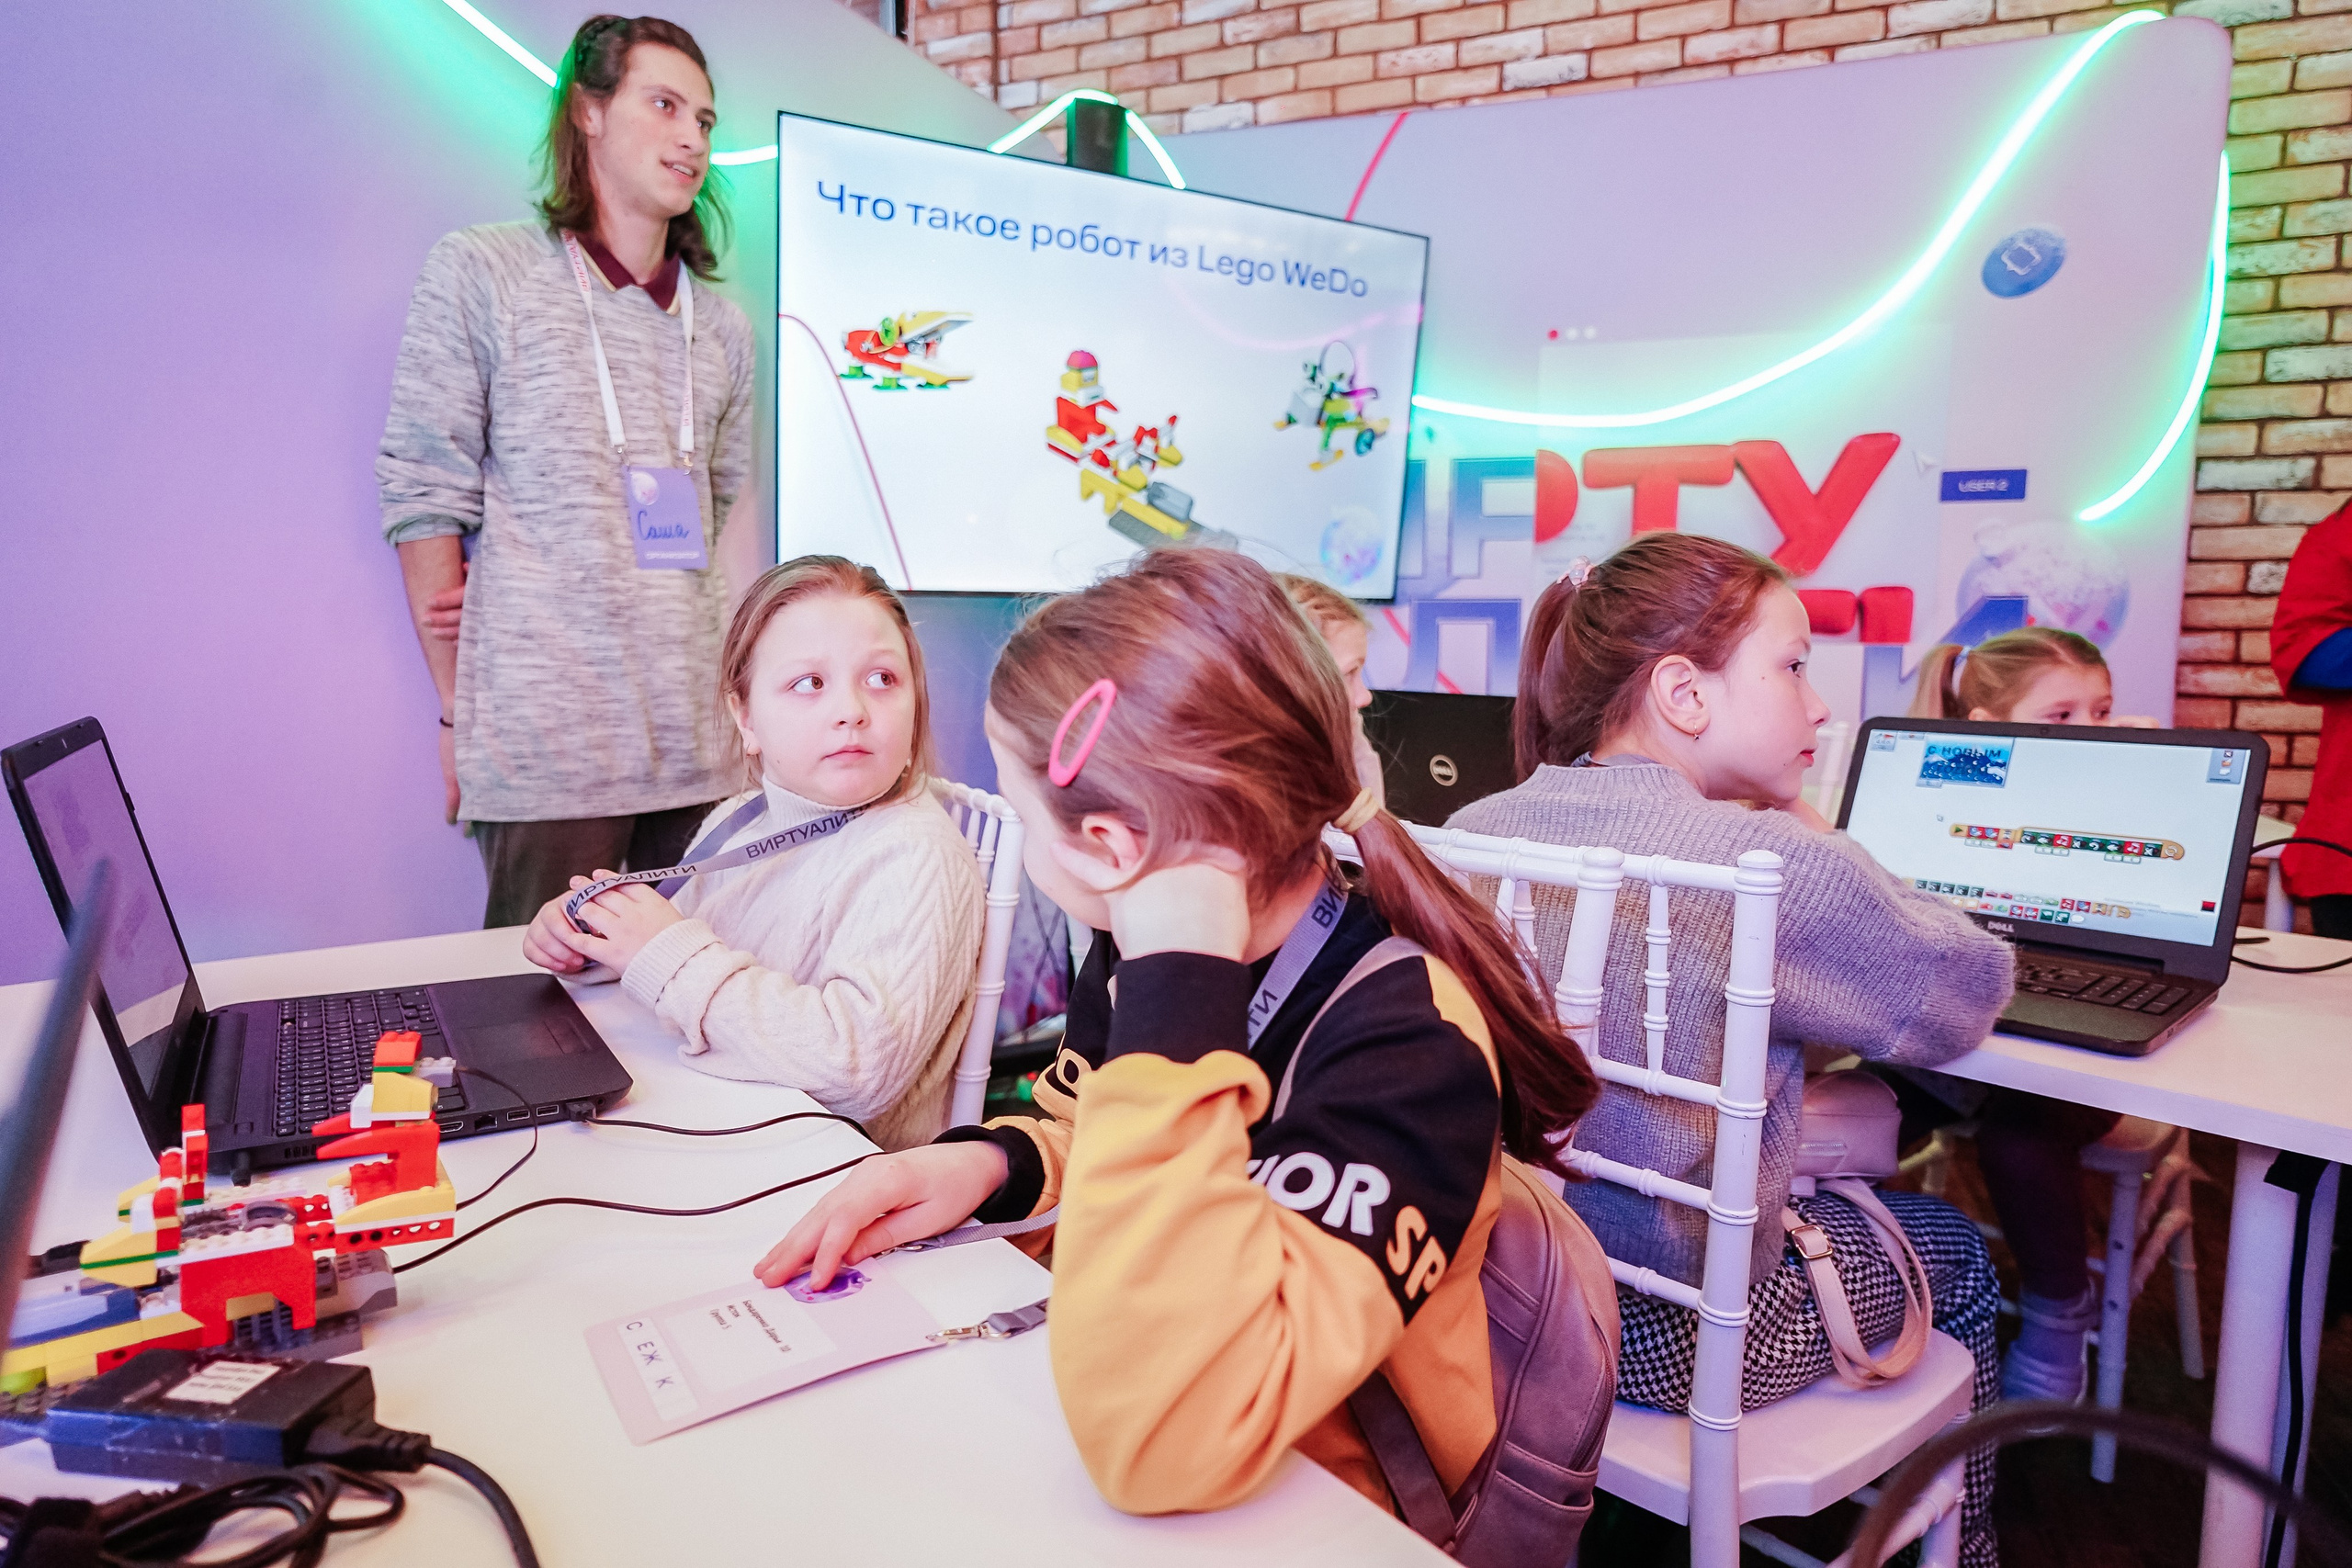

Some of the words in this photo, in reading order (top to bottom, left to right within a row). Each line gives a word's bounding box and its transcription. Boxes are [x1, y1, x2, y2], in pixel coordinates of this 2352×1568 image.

[817, 181, 895, 220] Что
[907, 203, 1020, 241] такое
[1032, 224, 1140, 260] робот
[1150, 244, 1188, 268] из
[1199, 245, 1274, 286] Lego
[1283, 260, 1368, 297] WeDo
[1997, 478, 2009, 491] 2
[1385, 1205, 1447, 1301] SP
